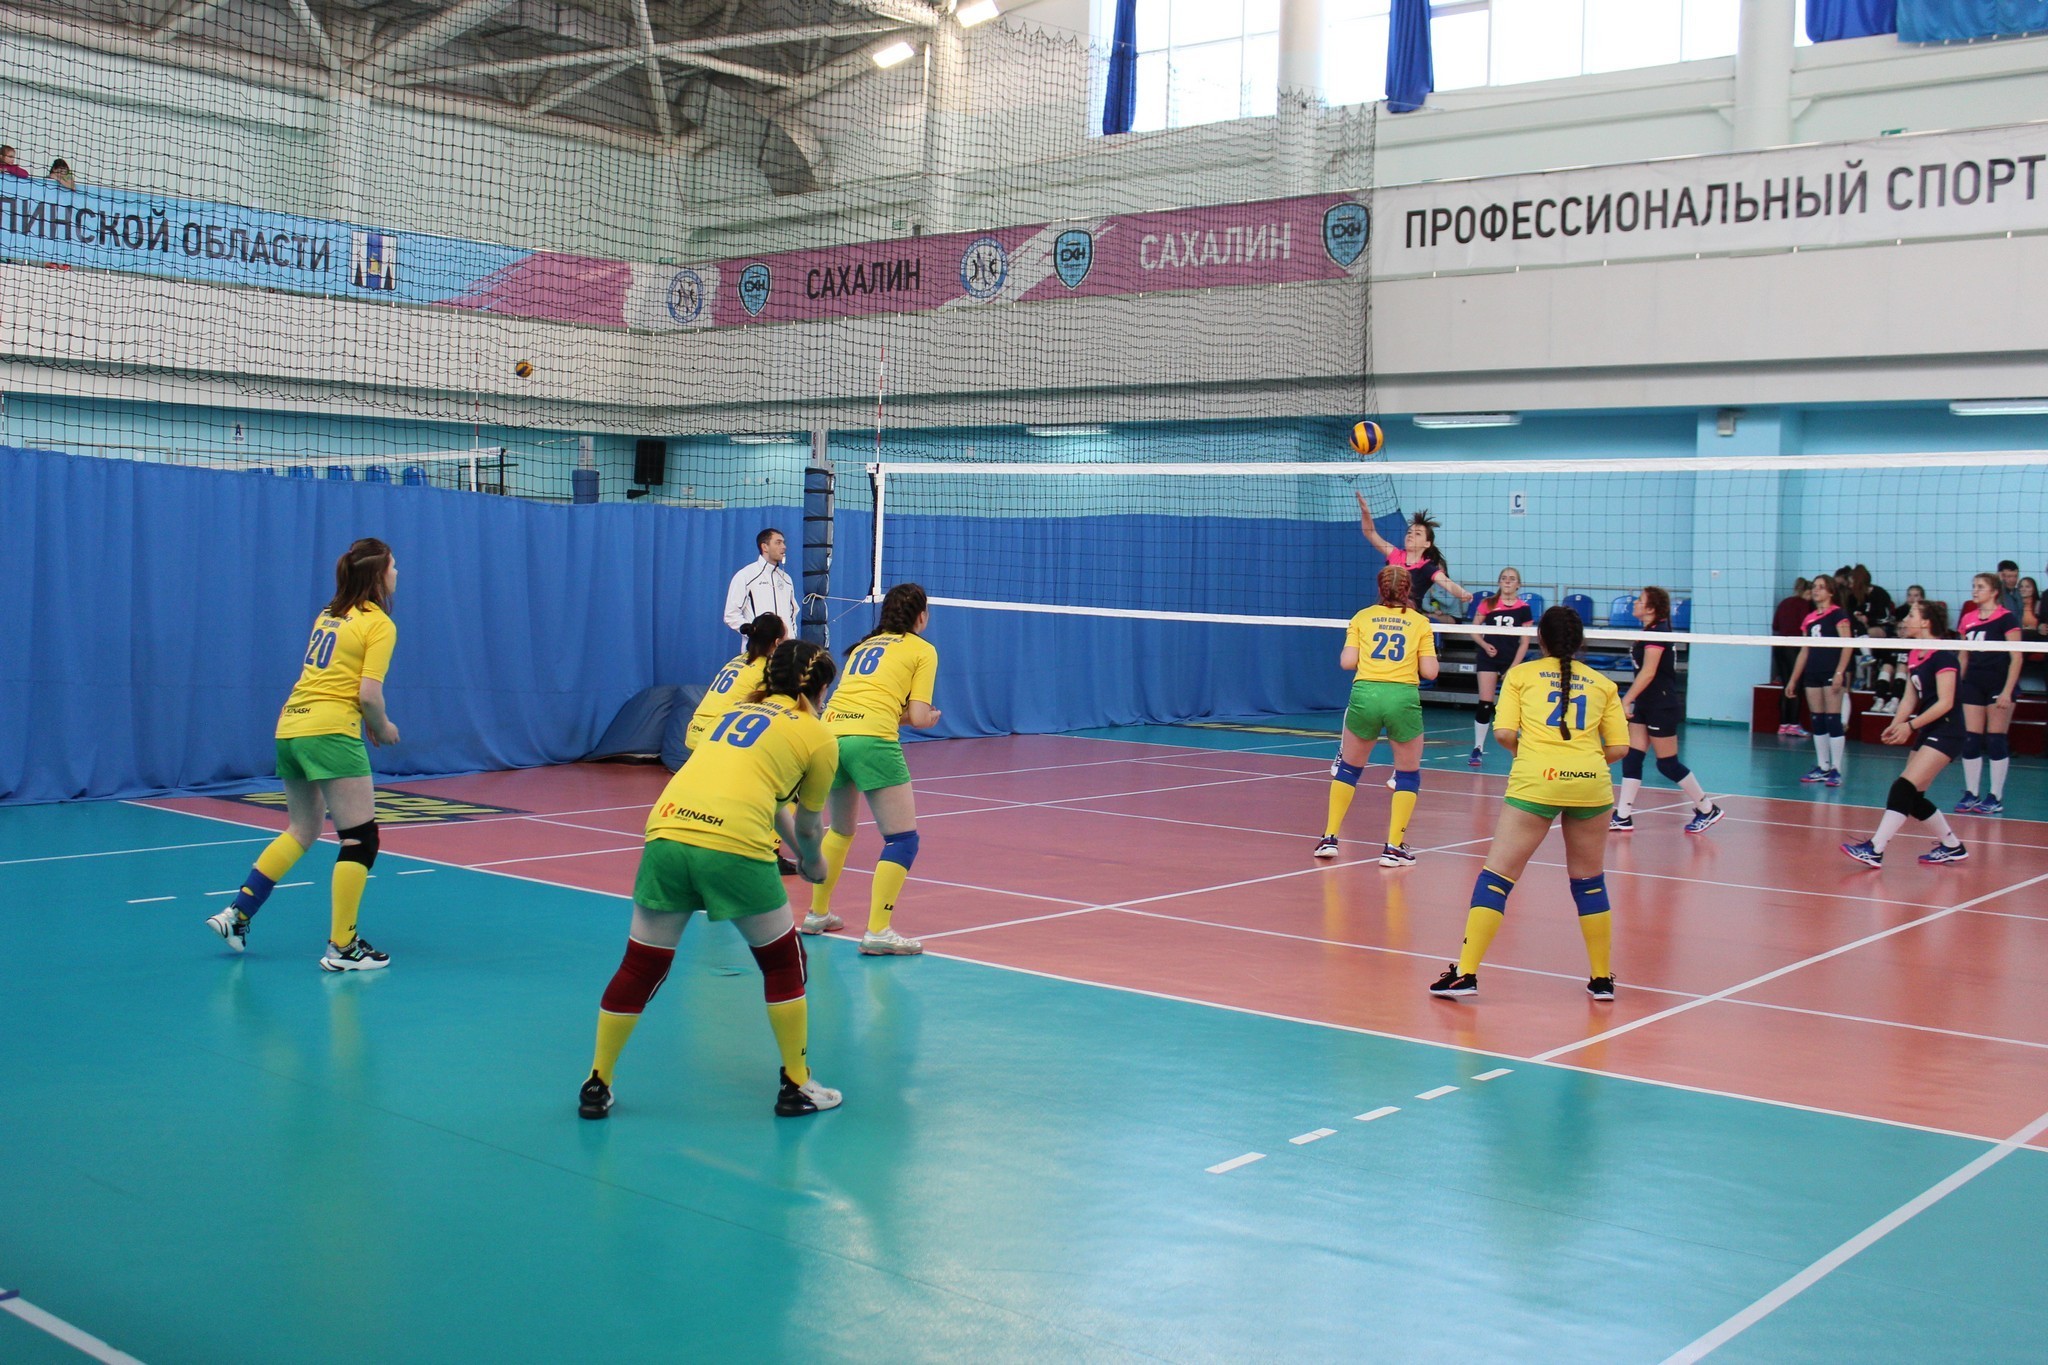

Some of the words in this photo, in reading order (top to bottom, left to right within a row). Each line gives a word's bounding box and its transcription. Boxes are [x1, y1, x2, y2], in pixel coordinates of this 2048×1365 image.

[1405, 160, 1867, 249] ПРОФЕССИОНАЛЬНЫЙ
[1888, 154, 2046, 211] СПОРТ
[182, 222, 330, 273] ОБЛАСТИ
[1140, 222, 1291, 271] САХАЛИН
[806, 258, 920, 300] САХАЛИН
[304, 628, 337, 669] 20
[848, 646, 886, 675] 18
[1370, 632, 1407, 662] 23
[710, 669, 739, 694] 16
[709, 710, 771, 748] 19
[1545, 690, 1587, 731] 21
[1559, 771, 1597, 779] KINASH
[676, 807, 724, 827] KINASH
